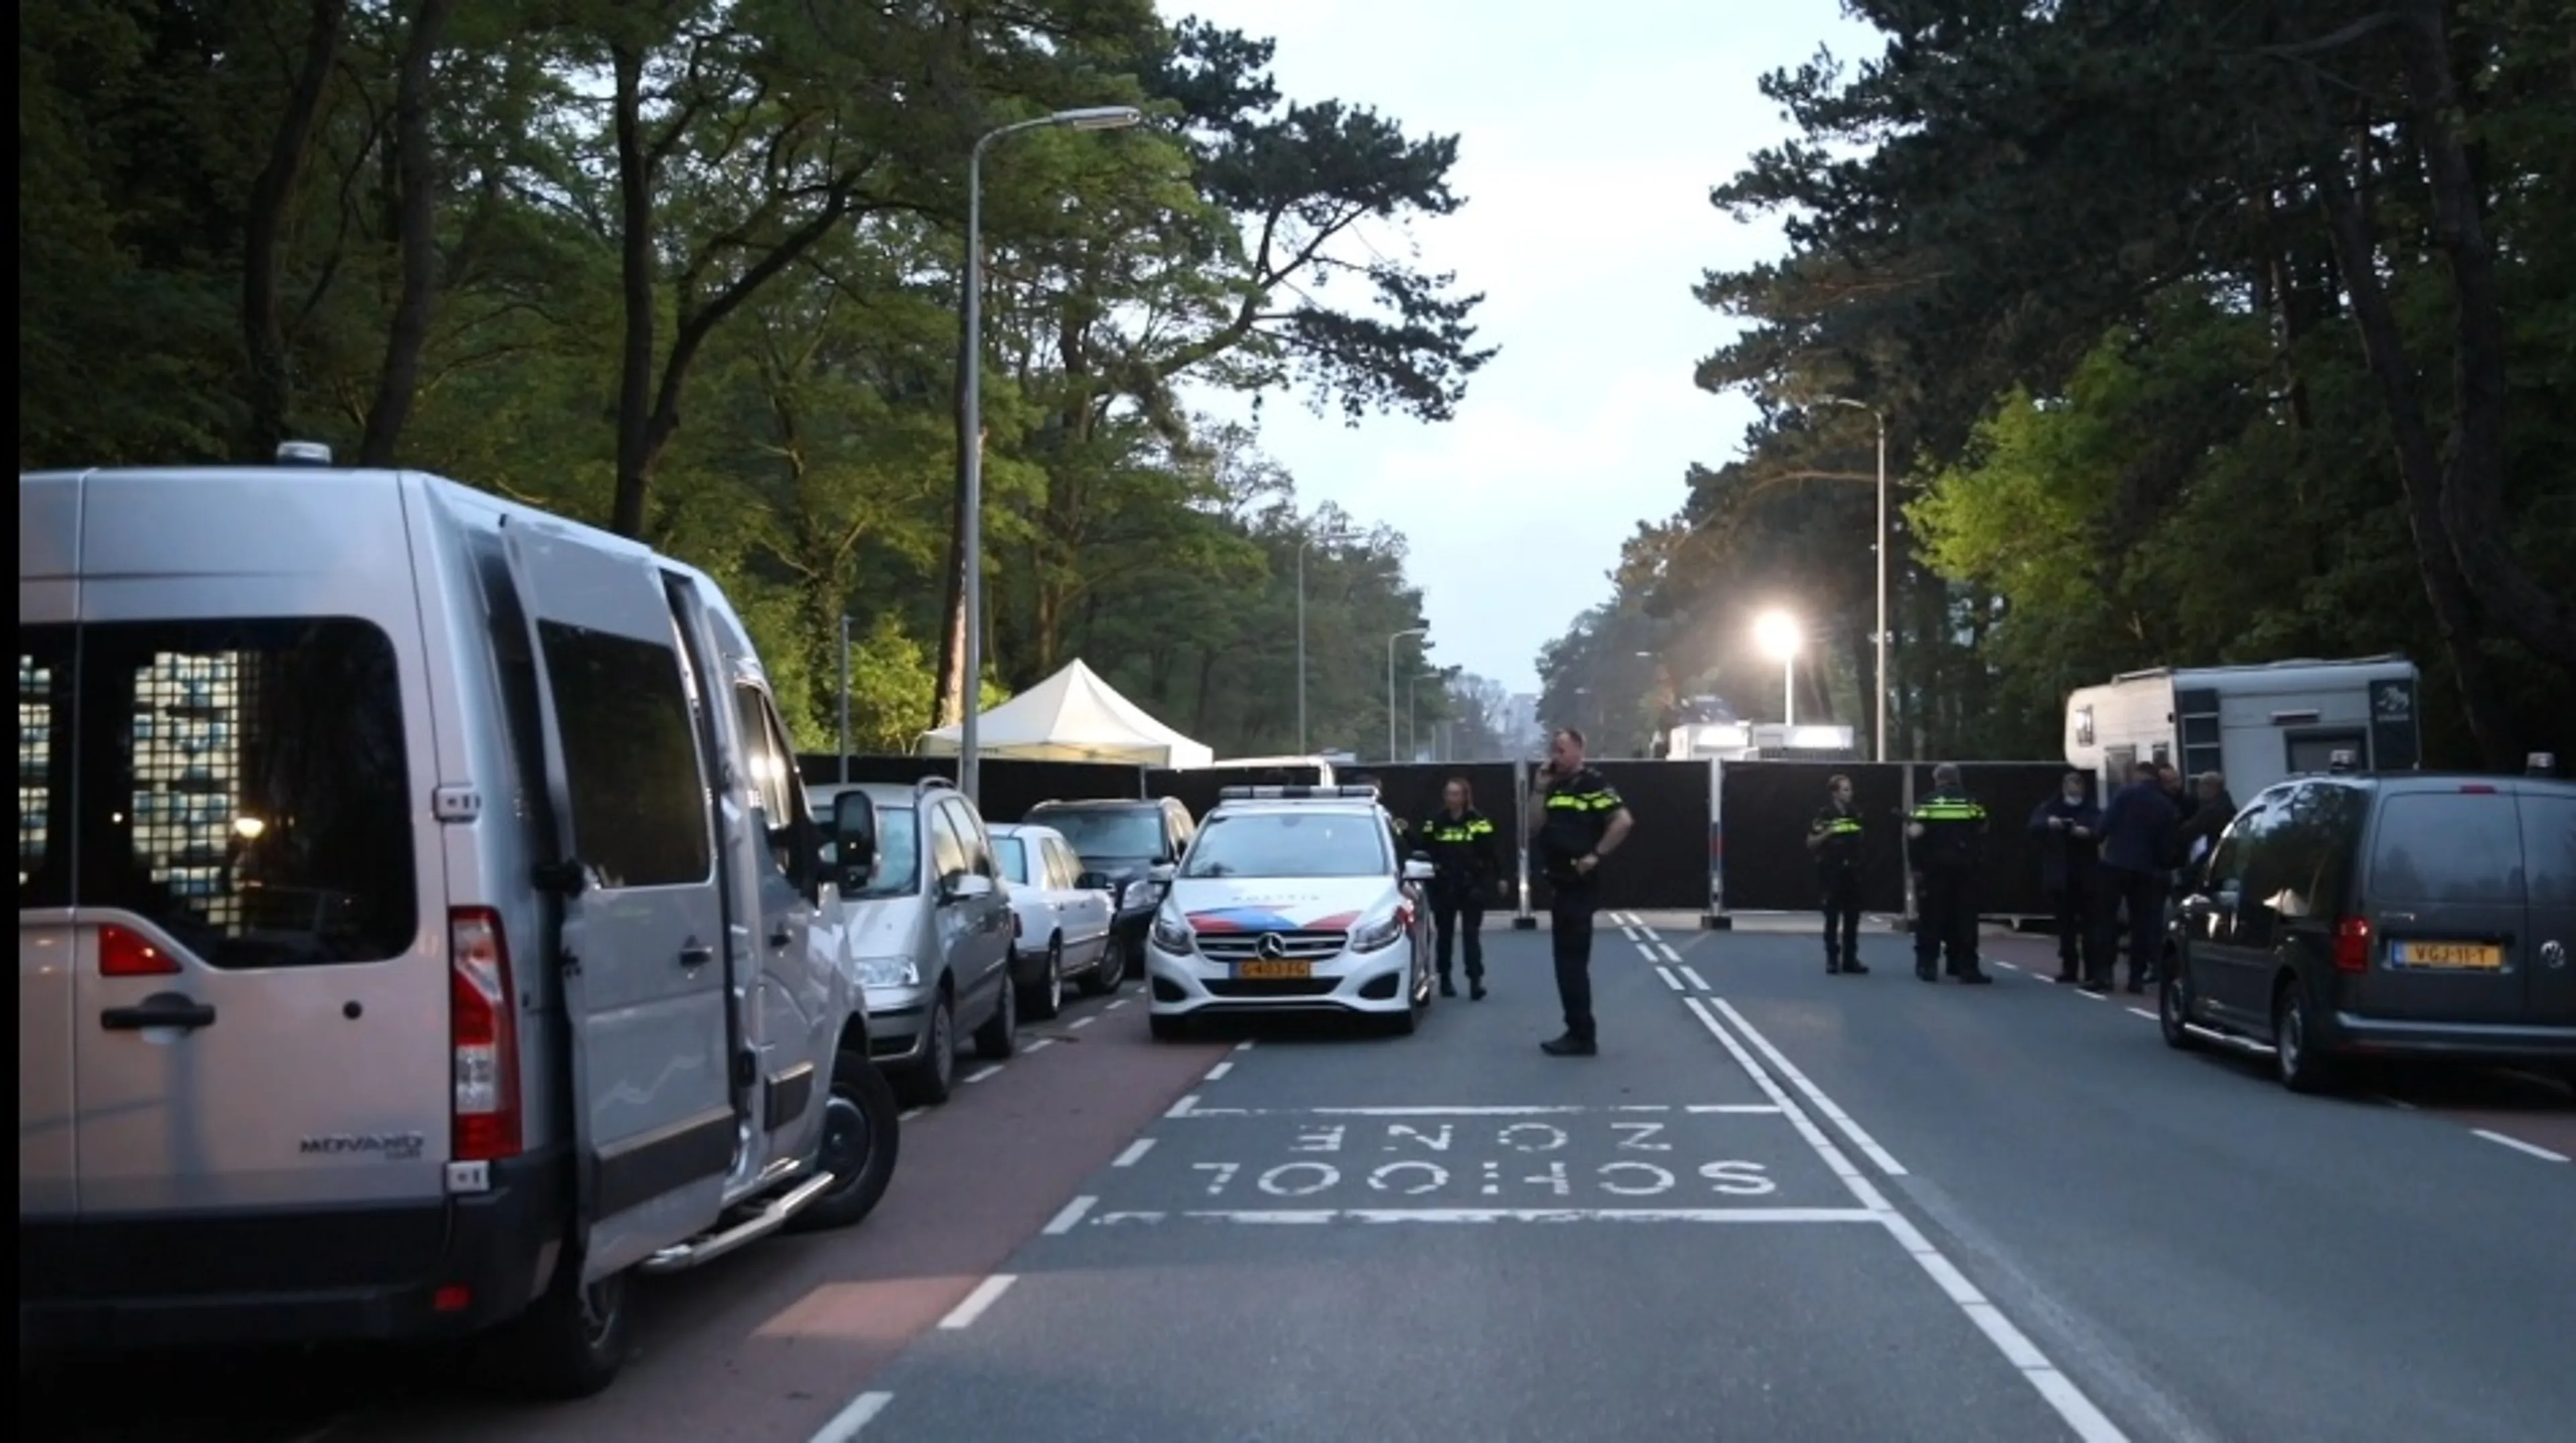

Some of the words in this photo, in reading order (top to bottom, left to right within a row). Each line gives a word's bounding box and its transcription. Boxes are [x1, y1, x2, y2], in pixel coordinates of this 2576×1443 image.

[2414, 944, 2487, 963] VGJ-11-T
[299, 1135, 425, 1154] MOVANO
[1193, 1159, 1778, 1195] SCHOOL
